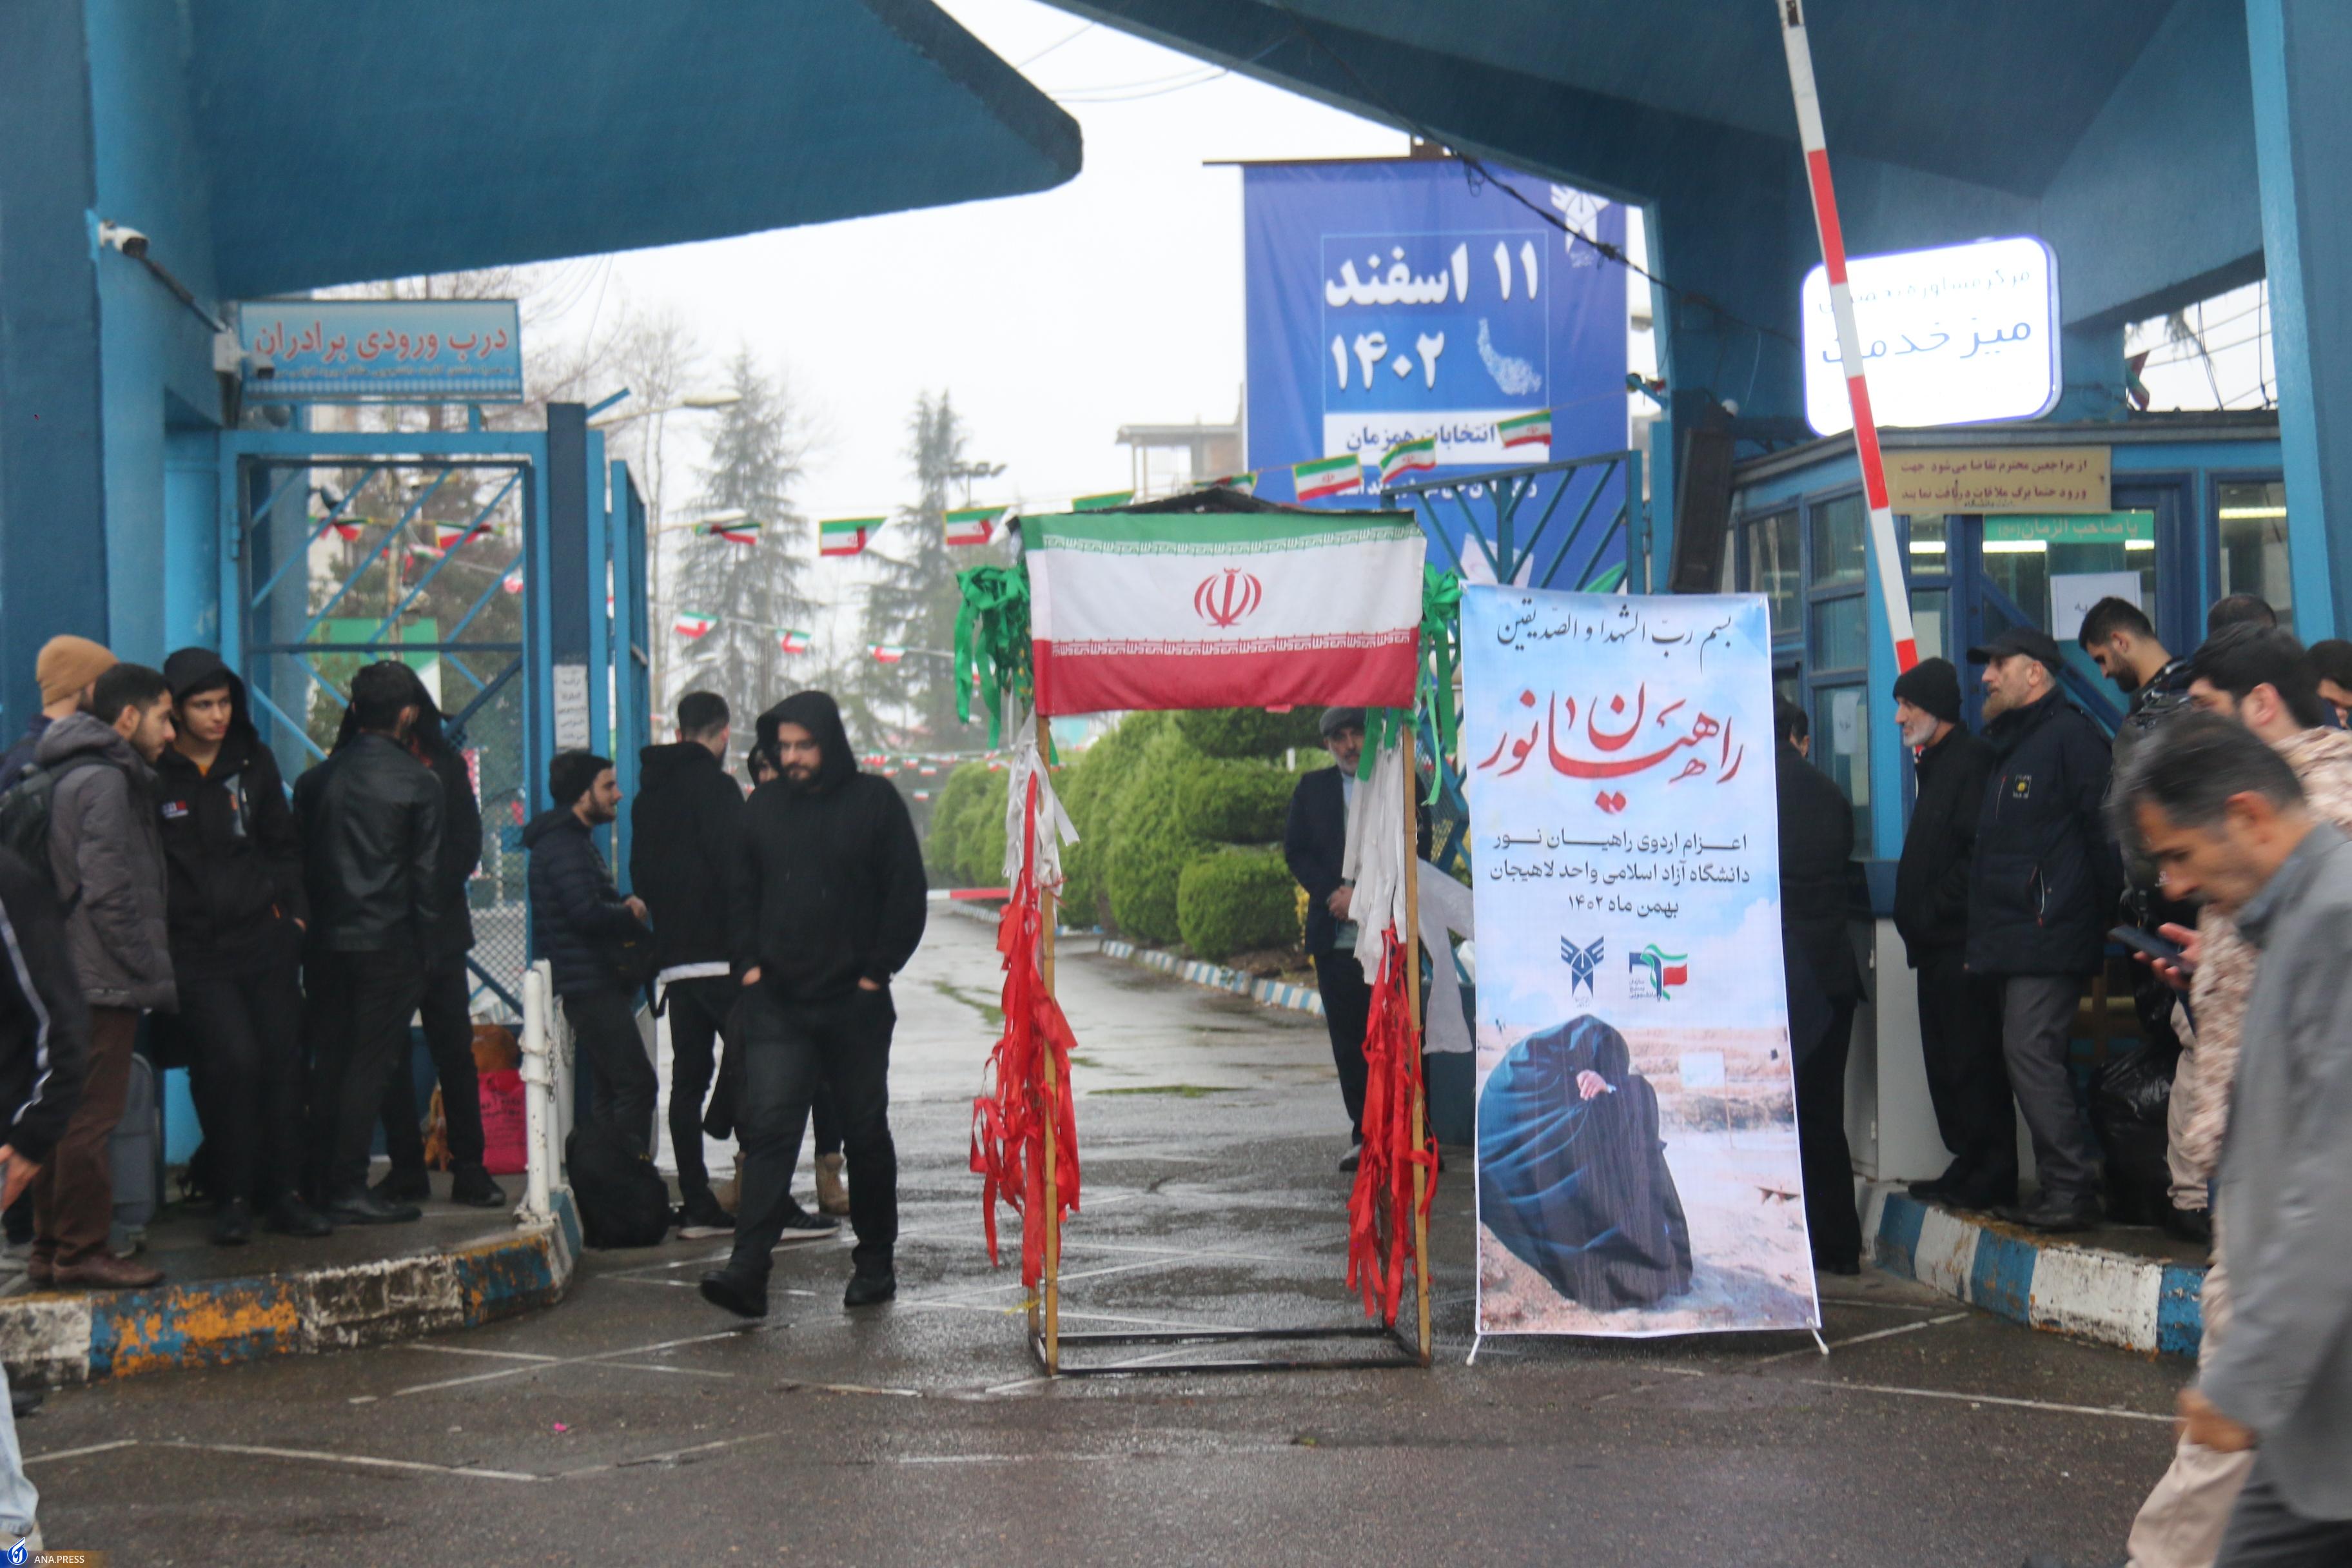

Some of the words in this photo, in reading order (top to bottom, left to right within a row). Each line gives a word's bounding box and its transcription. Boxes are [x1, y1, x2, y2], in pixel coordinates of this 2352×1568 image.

[1325, 241, 1469, 308] اسفند
[1494, 240, 1539, 302] ۱۱
[255, 320, 347, 362] برادران
[357, 329, 439, 360] ورودی
[448, 328, 508, 360] درب
[1959, 317, 2032, 359] میز
[1331, 331, 1445, 391] ۱۴۰۲
[1901, 460, 1925, 472] جهت
[1970, 458, 1996, 469] تقاضا
[1999, 460, 2030, 474] محترم
[2031, 458, 2075, 475] مراجعین
[2077, 458, 2088, 473] از
[1935, 484, 1971, 501] دریافت
[1973, 485, 2008, 499] ملاقات
[2012, 485, 2032, 501] برگ
[2059, 487, 2087, 501] ورود
[2072, 518, 2123, 539] صاحب
[2126, 518, 2139, 538] یا
[1584, 625, 1593, 642] و
[1700, 614, 1732, 675] بسم
[1477, 689, 1540, 777] نور
[1493, 828, 1542, 850] نور
[1546, 827, 1633, 853] راهیان
[1637, 831, 1678, 854] اردوی
[1683, 830, 1747, 858] اعزام
[1490, 858, 1555, 882] لاهیجان
[1558, 859, 1598, 884] واحد
[1602, 862, 1658, 885] اسلامی
[1661, 859, 1687, 887] آزاد
[1689, 861, 1750, 883] دانشگاه
[1568, 894, 1603, 910] ۱۴۰۲
[1608, 894, 1633, 912] ماه
[1637, 901, 1680, 919] بهمن
